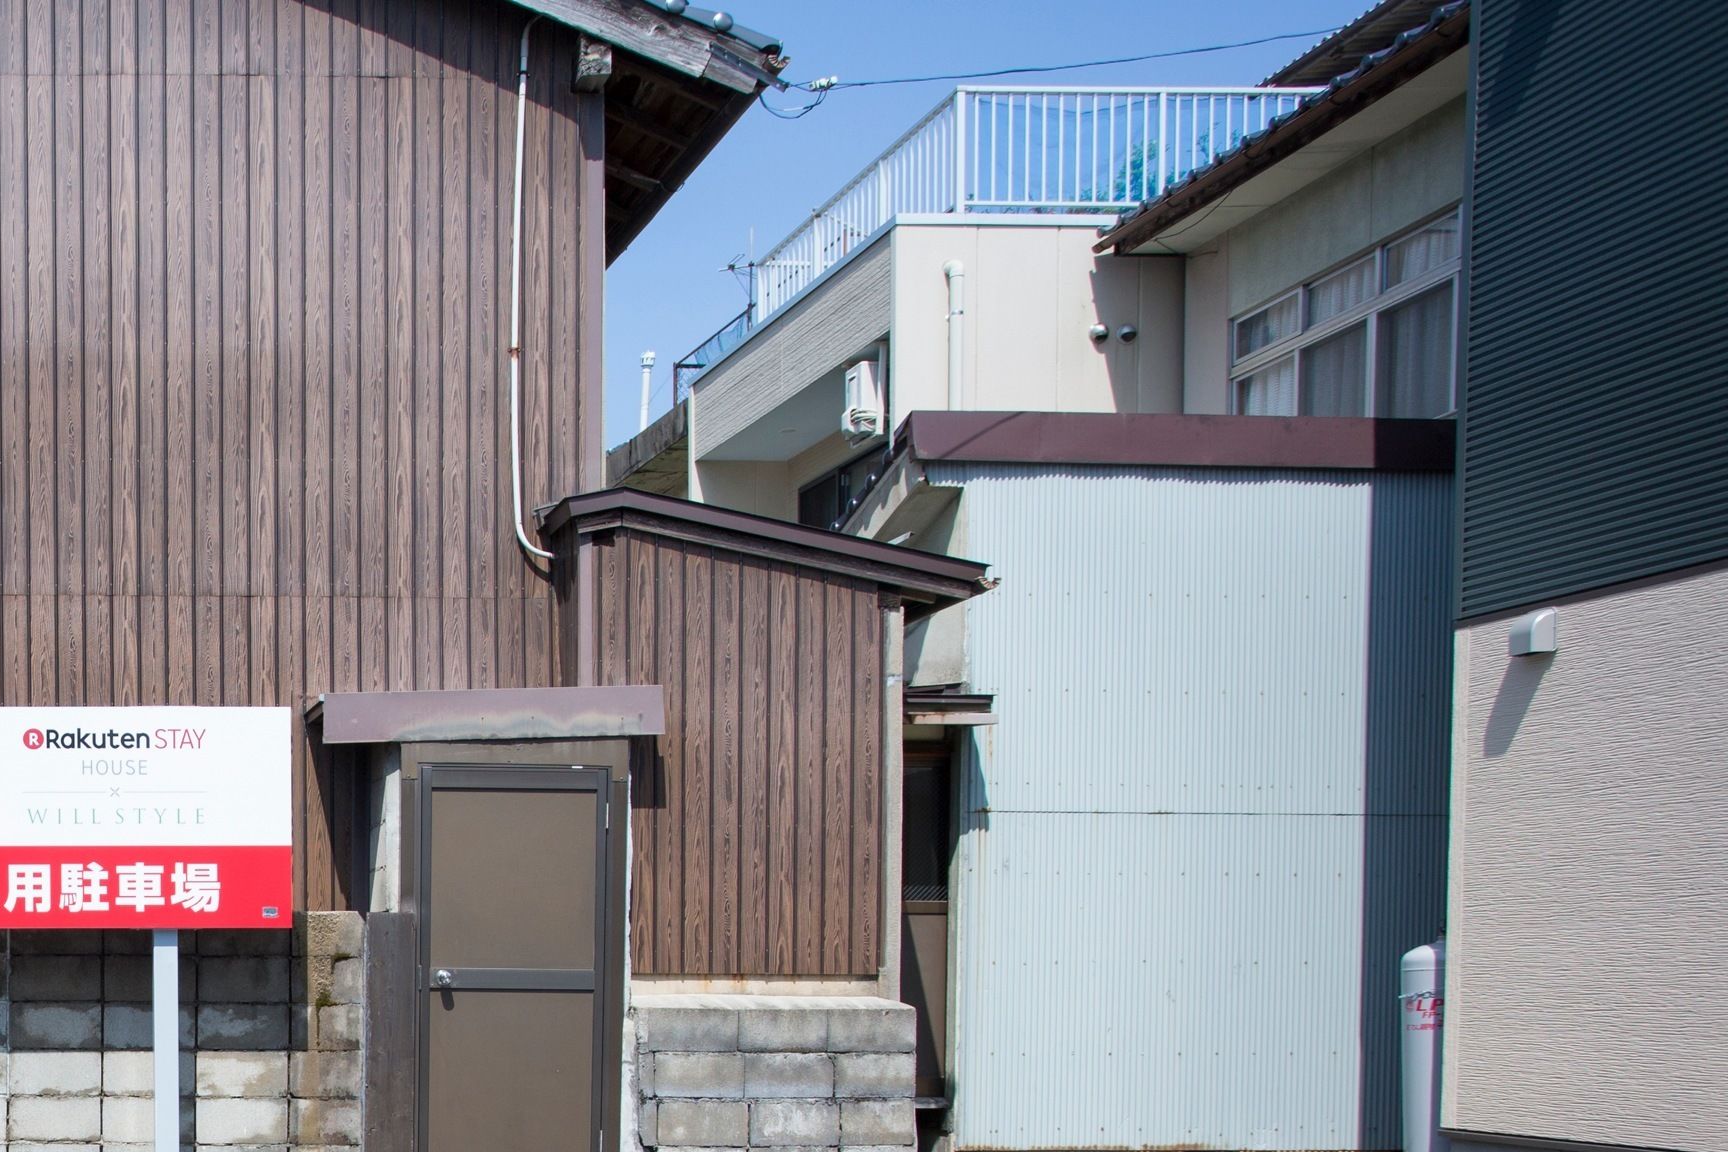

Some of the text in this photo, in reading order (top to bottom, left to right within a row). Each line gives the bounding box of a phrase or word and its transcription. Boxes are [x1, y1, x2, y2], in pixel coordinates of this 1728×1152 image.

[46, 728, 150, 749] Rakuten
[155, 729, 206, 749] STAY
[81, 760, 148, 776] HOUSE
[27, 808, 206, 825] WILL STYLE
